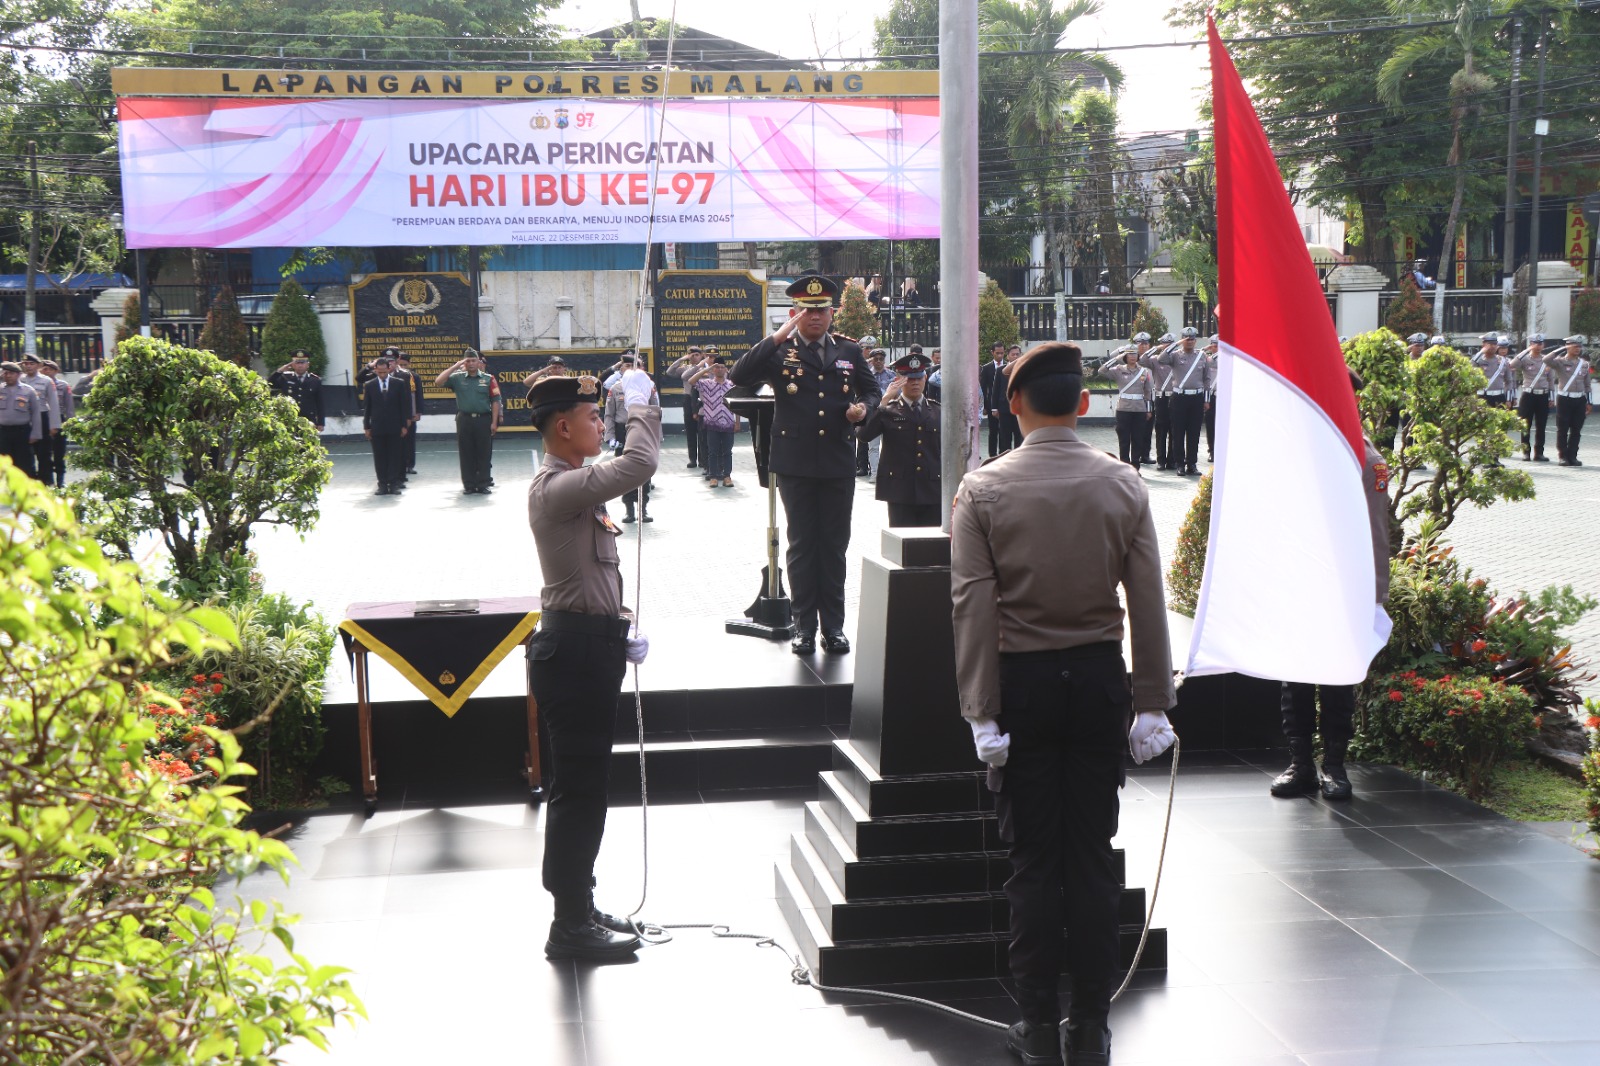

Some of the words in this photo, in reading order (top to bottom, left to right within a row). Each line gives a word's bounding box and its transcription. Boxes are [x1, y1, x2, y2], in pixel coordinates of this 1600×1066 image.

[222, 73, 463, 94] LAPANGAN
[496, 74, 659, 94] POLRES
[691, 74, 864, 94] MALANG
[576, 112, 594, 127] 97
[409, 142, 541, 166] UPACARA
[547, 140, 714, 164] PERINGATAN
[409, 174, 507, 207] HARI
[521, 173, 585, 207] IBU
[601, 172, 715, 205] KE-97
[458, 216, 501, 226] BERDAYA
[504, 216, 525, 225] DAN
[528, 215, 580, 226] BERKARYA,
[583, 215, 622, 224] MENUJU
[624, 214, 677, 224] INDONESIA
[679, 214, 705, 223] EMAS
[511, 234, 547, 243] MALANG,
[548, 234, 557, 242] 22
[559, 233, 600, 242] DESEMBER
[601, 233, 619, 241] 2025
[665, 288, 695, 299] CATUR
[698, 288, 747, 299] PRASETYA
[388, 315, 404, 326] TRI
[407, 315, 438, 326] BRATA
